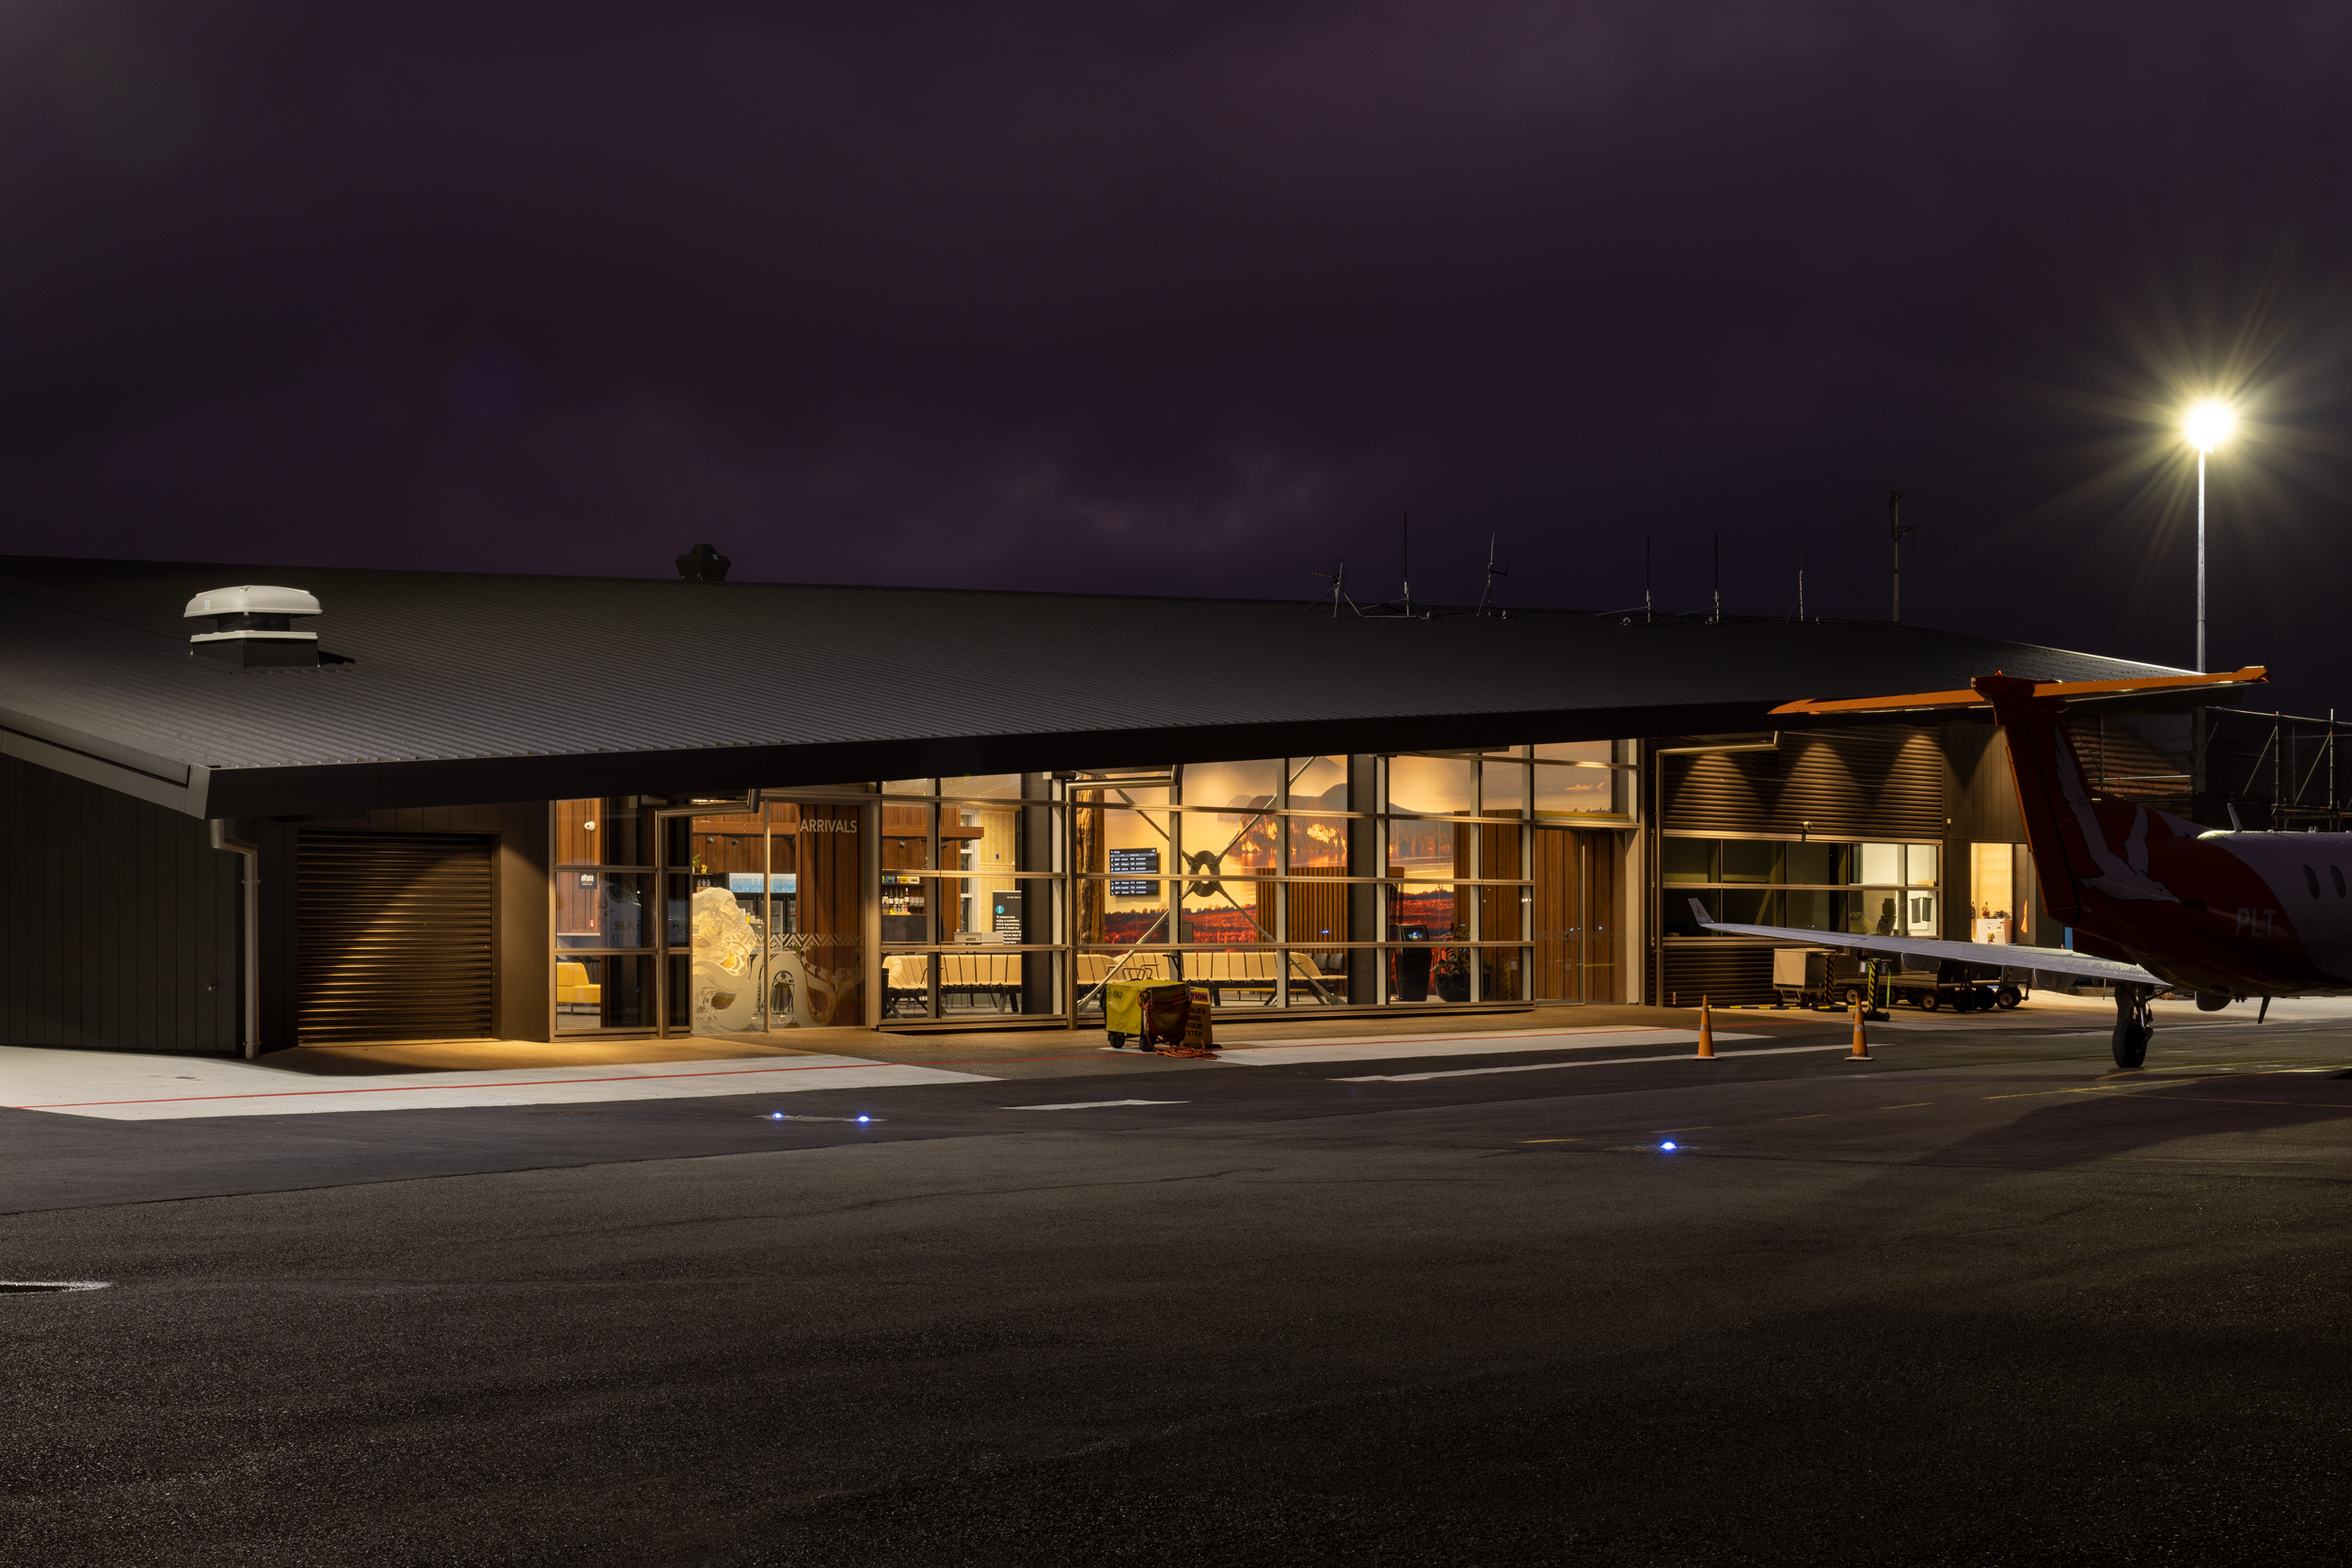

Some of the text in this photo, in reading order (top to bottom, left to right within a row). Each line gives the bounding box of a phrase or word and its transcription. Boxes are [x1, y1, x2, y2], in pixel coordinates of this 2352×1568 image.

[800, 818, 857, 833] ARRIVALS
[731, 879, 771, 888] CHILLE
[2234, 907, 2277, 939] PLT
